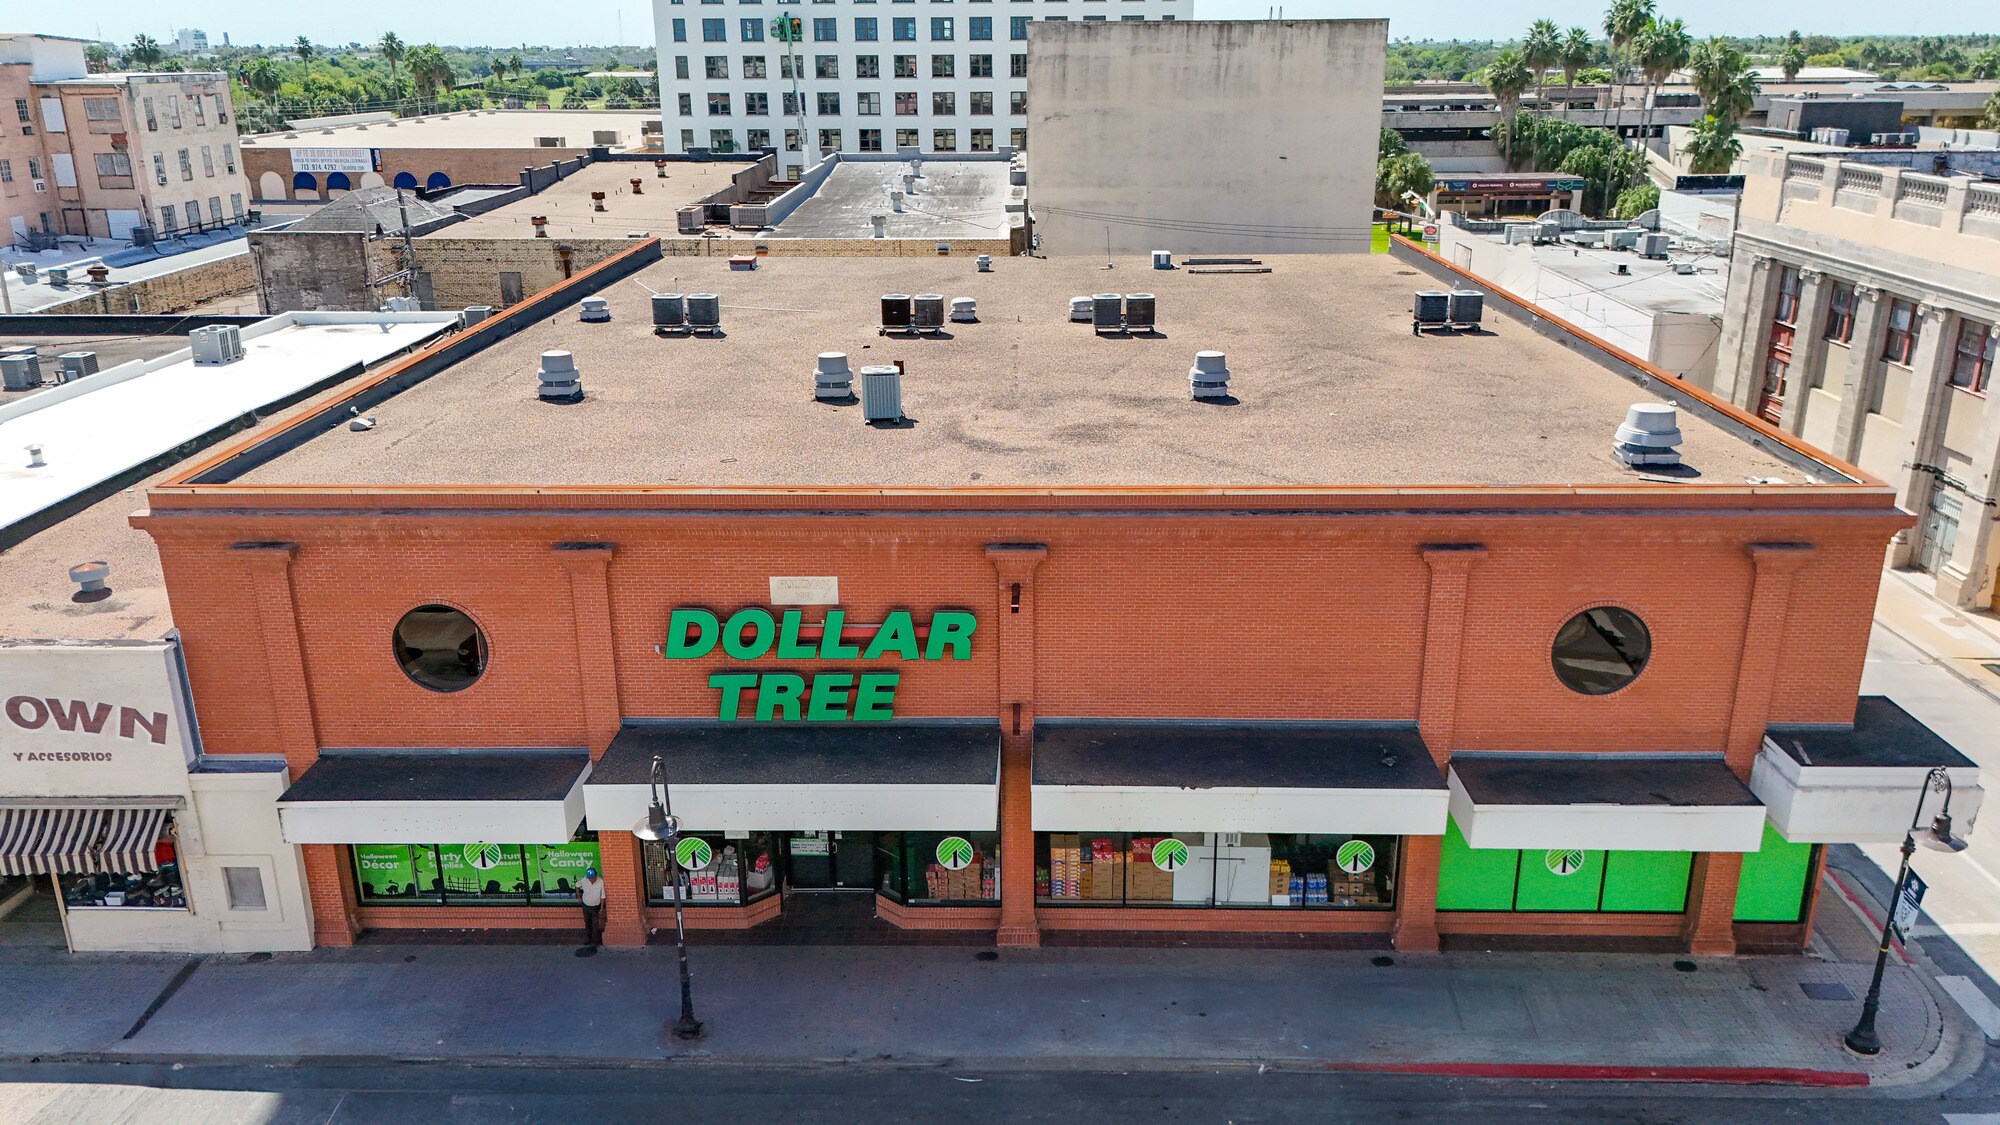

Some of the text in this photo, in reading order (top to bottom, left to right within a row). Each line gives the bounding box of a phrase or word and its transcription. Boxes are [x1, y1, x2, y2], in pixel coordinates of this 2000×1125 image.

[664, 607, 977, 661] DOLLAR
[708, 671, 901, 722] TREE
[13, 751, 112, 762] Y ACCESORIOS
[361, 859, 400, 869] Décor
[549, 857, 594, 869] Candy
